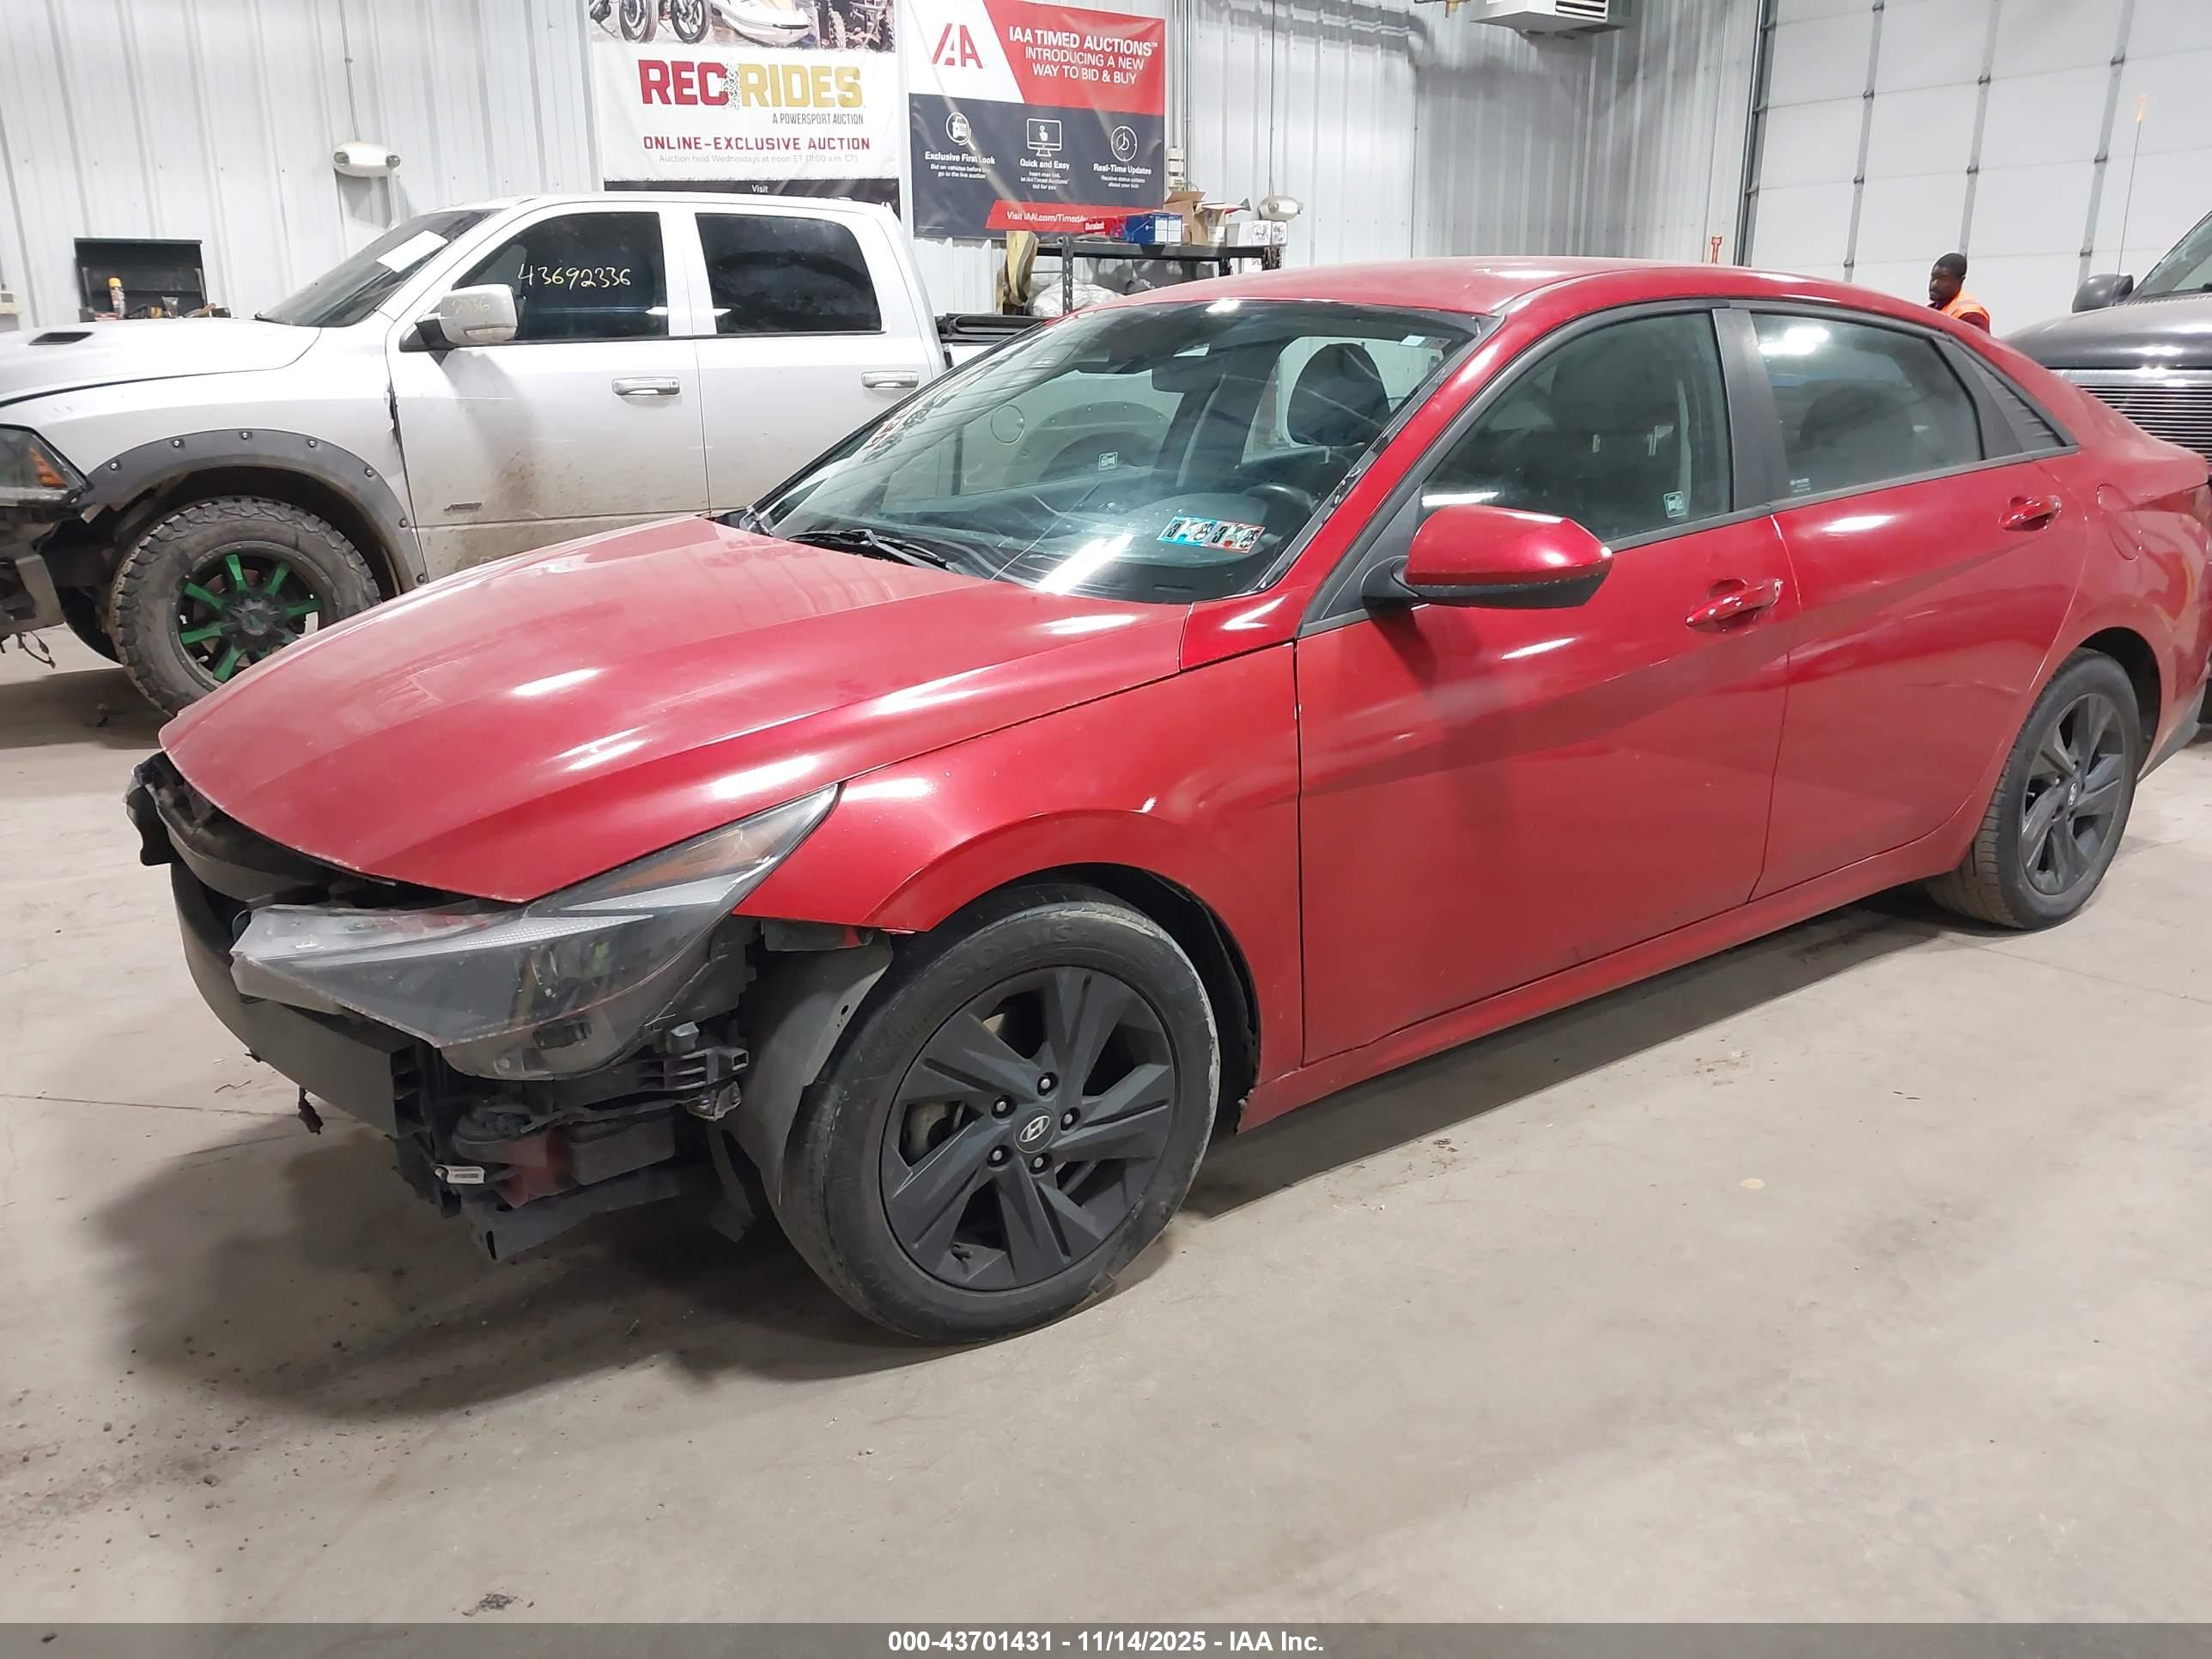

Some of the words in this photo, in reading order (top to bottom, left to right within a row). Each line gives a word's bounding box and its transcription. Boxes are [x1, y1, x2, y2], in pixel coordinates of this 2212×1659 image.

[1009, 26, 1033, 43] IAA
[1035, 29, 1080, 48] TIMED
[1025, 46, 1104, 67] INTRODUCING
[1107, 55, 1115, 68] A
[1118, 57, 1144, 70] NEW
[1032, 63, 1060, 76] WAY
[1062, 65, 1079, 79] TO
[1081, 68, 1099, 82] BID
[1102, 70, 1110, 82] &
[1113, 70, 1137, 84] BUY
[638, 59, 731, 106] REC
[738, 64, 863, 108] RIDES
[773, 113, 778, 124] A
[780, 113, 830, 125] POWERSPORT
[833, 114, 864, 125] AUCTION
[644, 136, 801, 150] ONLINE-EXCLUSIVE
[808, 137, 871, 150] AUCTION
[659, 154, 690, 163] Auction
[692, 155, 709, 163] held
[712, 155, 761, 165] Wednesdays
[793, 155, 803, 164] ET
[925, 151, 960, 161] Exclusive
[962, 154, 978, 163] First
[1020, 158, 1038, 168] Quick
[1054, 161, 1070, 171] Easy
[1093, 162, 1127, 173] Real-Time
[1127, 164, 1152, 175] Updates
[751, 184, 769, 193] Visit
[1006, 210, 1023, 221] Visit
[518, 263, 631, 290] 43692336
